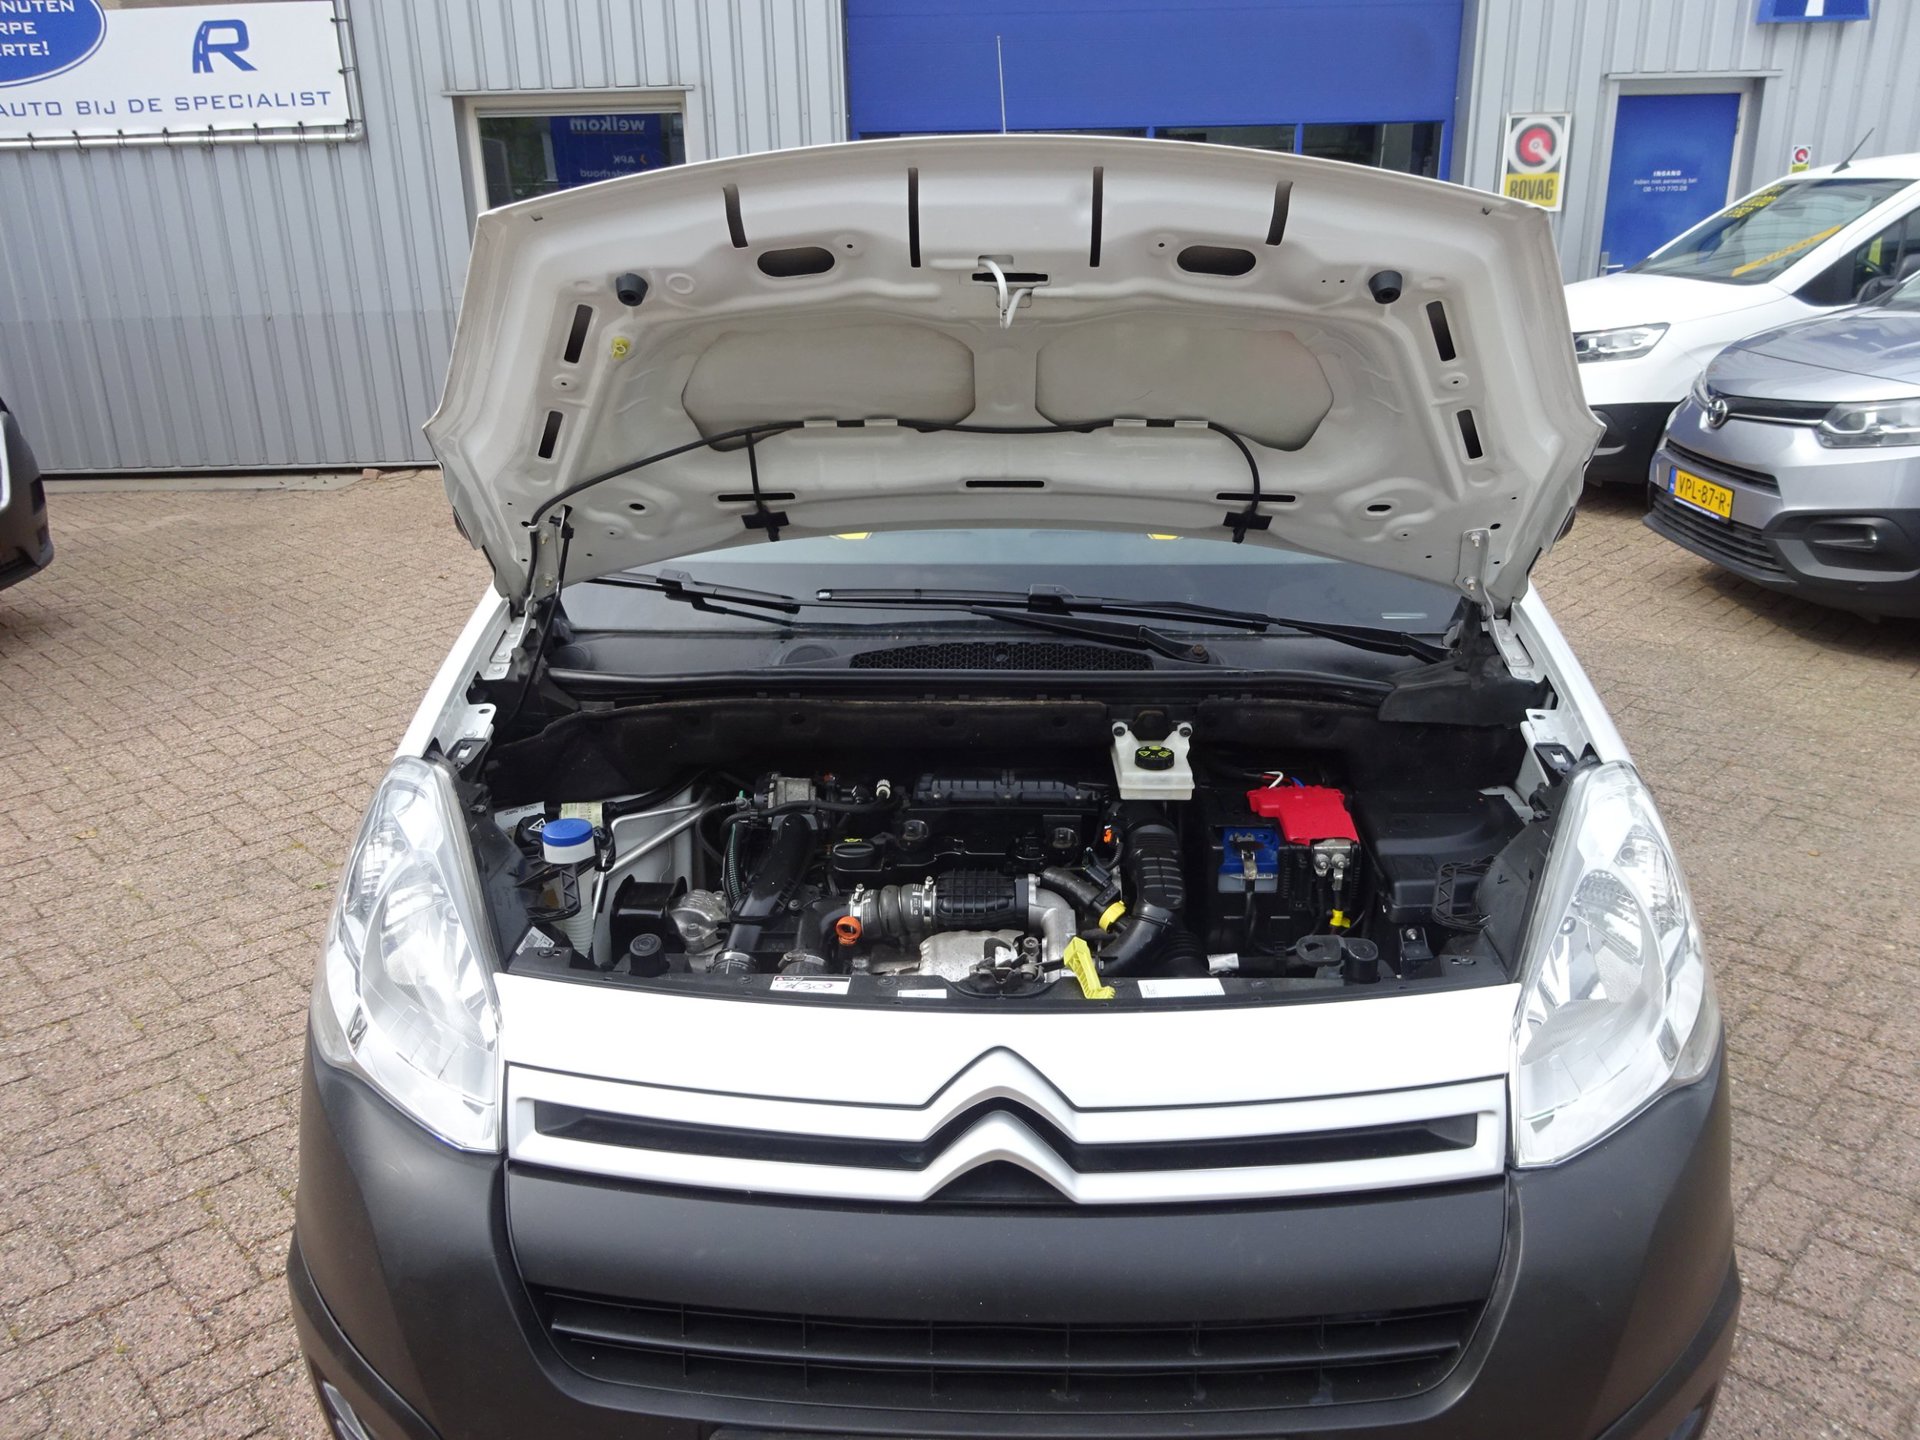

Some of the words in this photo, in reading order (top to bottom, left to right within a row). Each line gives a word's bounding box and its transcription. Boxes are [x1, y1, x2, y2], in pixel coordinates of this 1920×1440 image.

[0, 40, 50, 56] RTE!
[76, 100, 116, 115] BIJ
[128, 98, 162, 114] DE
[175, 91, 331, 111] SPECIALIST
[1509, 178, 1554, 200] BOVAG
[1679, 475, 1727, 512] VPL-87-R
